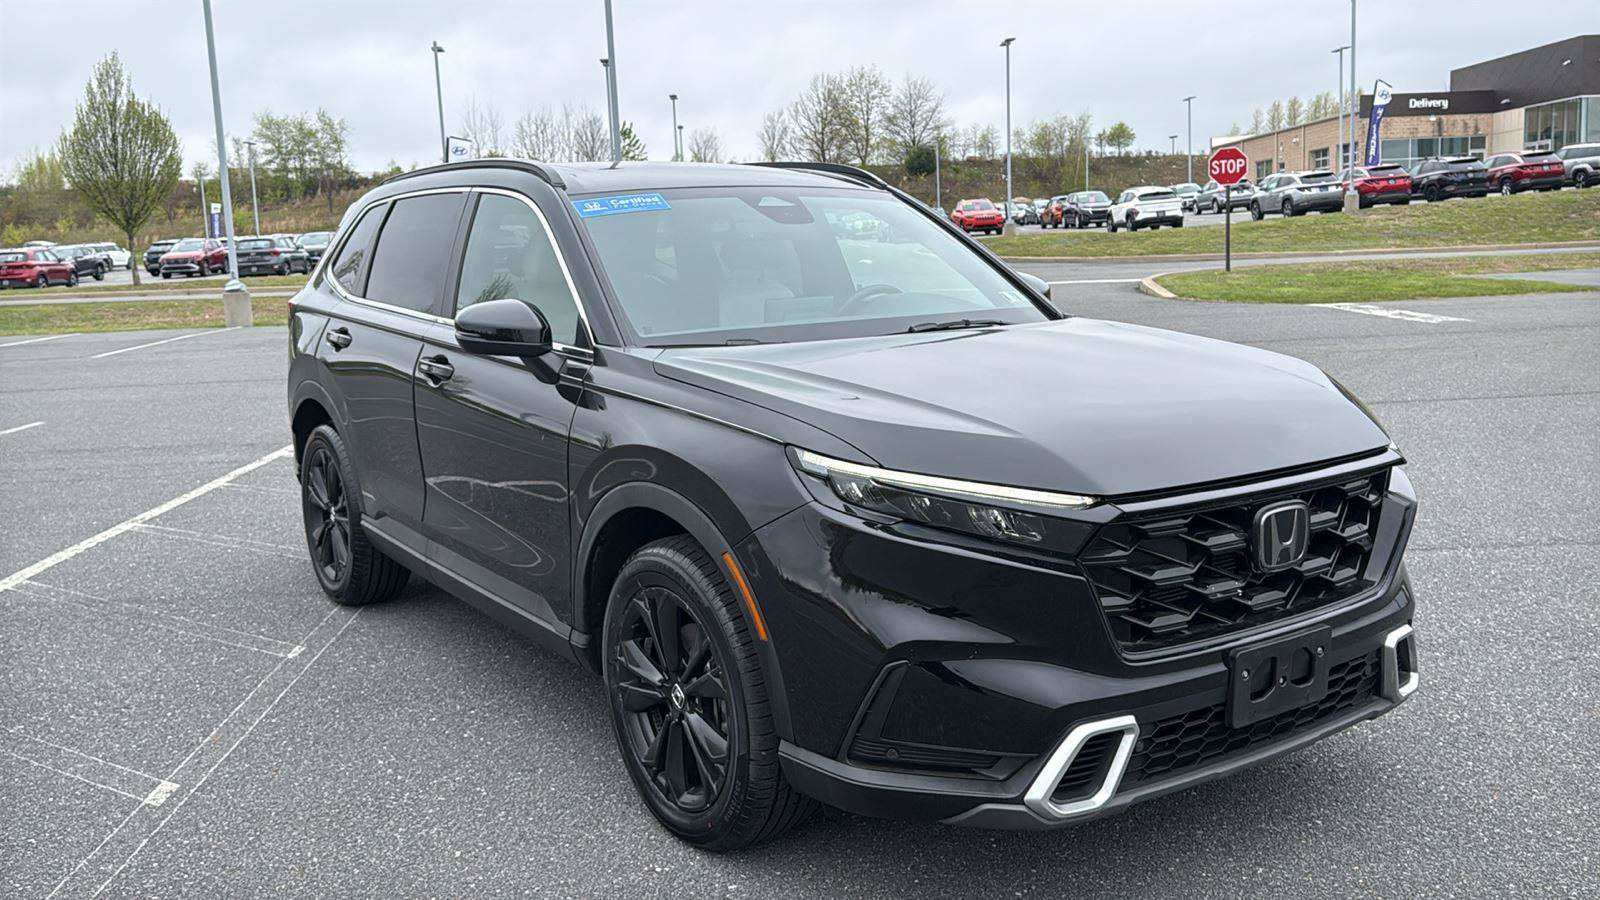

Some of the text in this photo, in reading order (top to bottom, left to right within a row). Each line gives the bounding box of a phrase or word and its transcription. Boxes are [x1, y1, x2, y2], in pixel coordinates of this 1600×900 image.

[1408, 98, 1449, 110] Delivery
[1211, 159, 1246, 175] STOP
[610, 196, 658, 205] Certified
